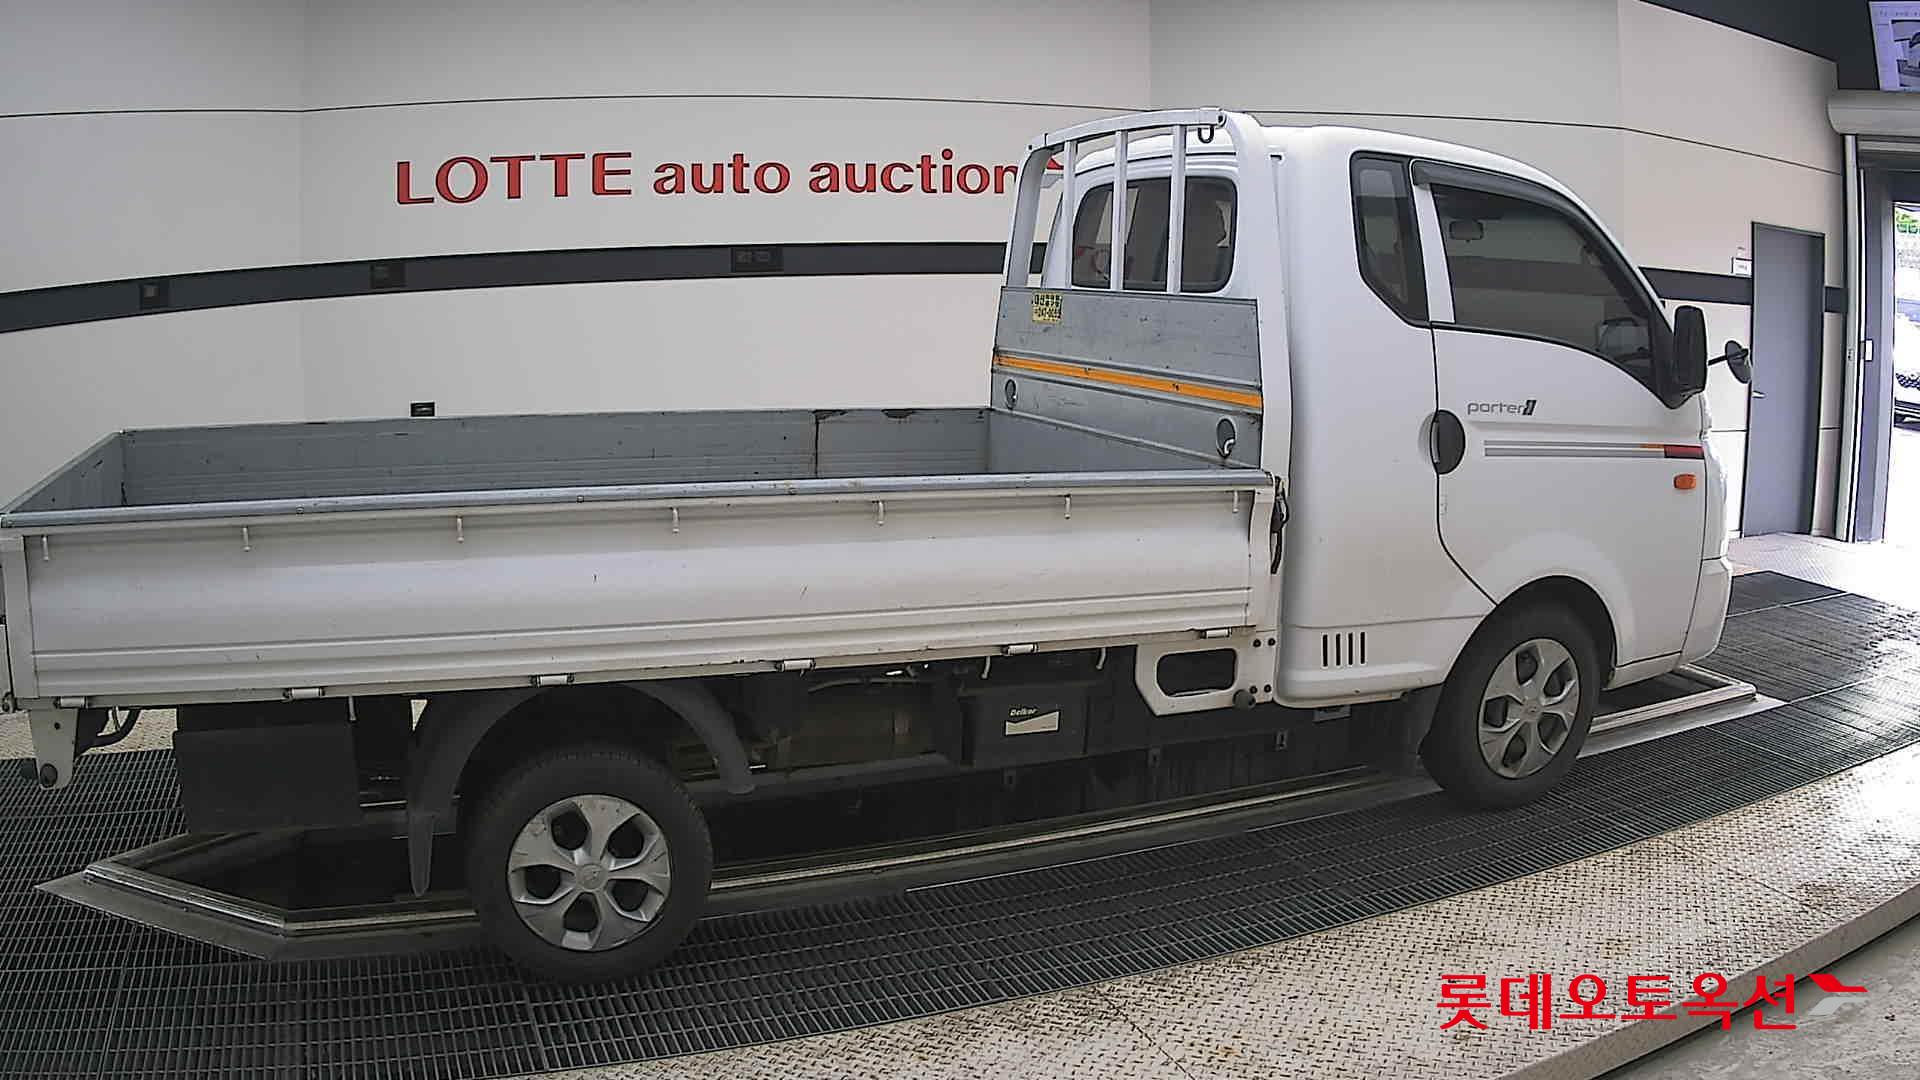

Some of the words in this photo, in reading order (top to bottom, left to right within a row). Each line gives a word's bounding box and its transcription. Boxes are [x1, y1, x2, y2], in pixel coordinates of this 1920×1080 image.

[396, 151, 632, 205] LOTTE
[653, 153, 791, 194] auto
[808, 148, 1019, 194] auction
